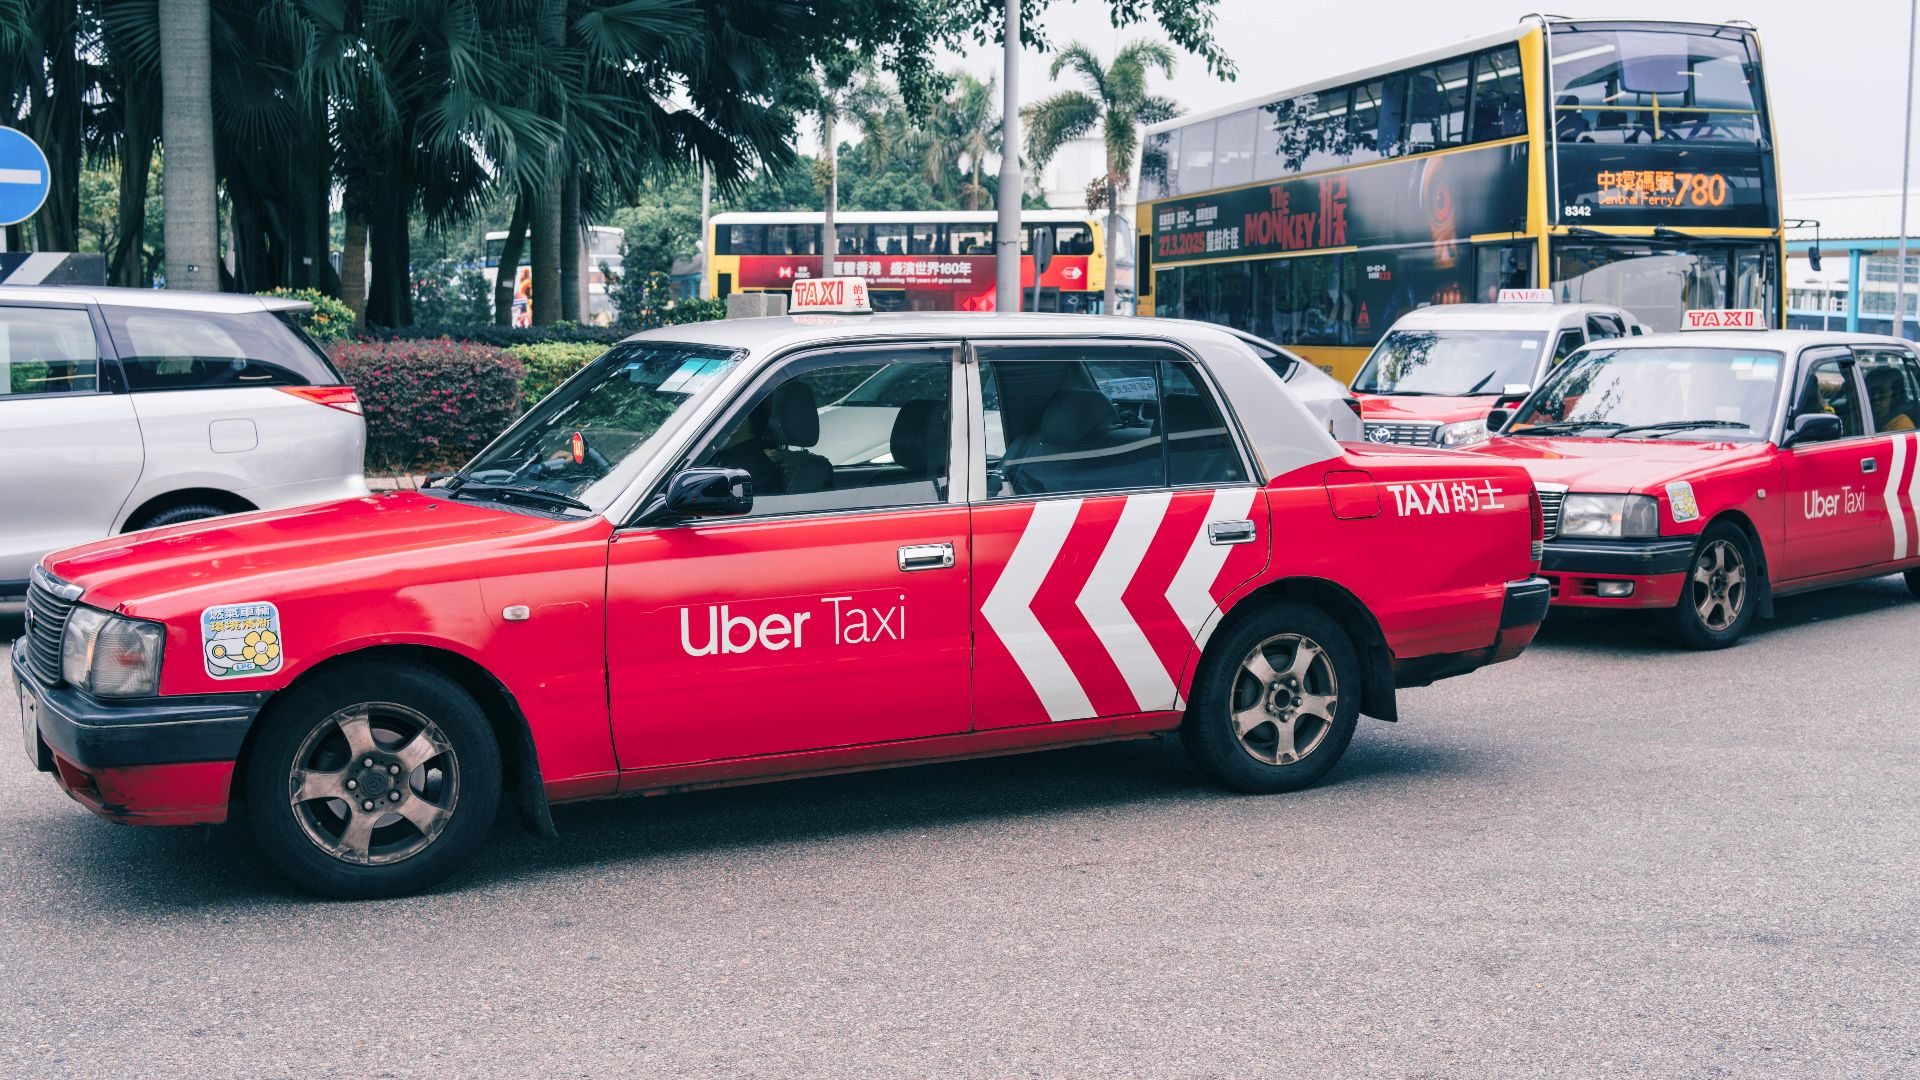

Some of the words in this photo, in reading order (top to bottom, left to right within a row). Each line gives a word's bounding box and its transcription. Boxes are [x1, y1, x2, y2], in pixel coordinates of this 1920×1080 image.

[1597, 170, 1674, 193] 中環碼頭
[1674, 173, 1726, 206] 780
[1565, 205, 1592, 217] 8342
[1598, 190, 1638, 205] Central
[1640, 191, 1675, 208] Ferry
[1318, 176, 1347, 247] 猴
[1244, 211, 1316, 250] MONKEY
[1158, 231, 1205, 257] 27.3.2025
[795, 281, 844, 307] TAXI
[853, 285, 865, 307] 的士
[1688, 311, 1754, 327] TAXI
[1804, 489, 1840, 520] Uber
[1841, 484, 1866, 515] Taxi
[209, 605, 271, 622] 燃氣車輛
[210, 617, 271, 632] 環境清新
[680, 604, 811, 657] Uber
[820, 594, 906, 645] Taxi
